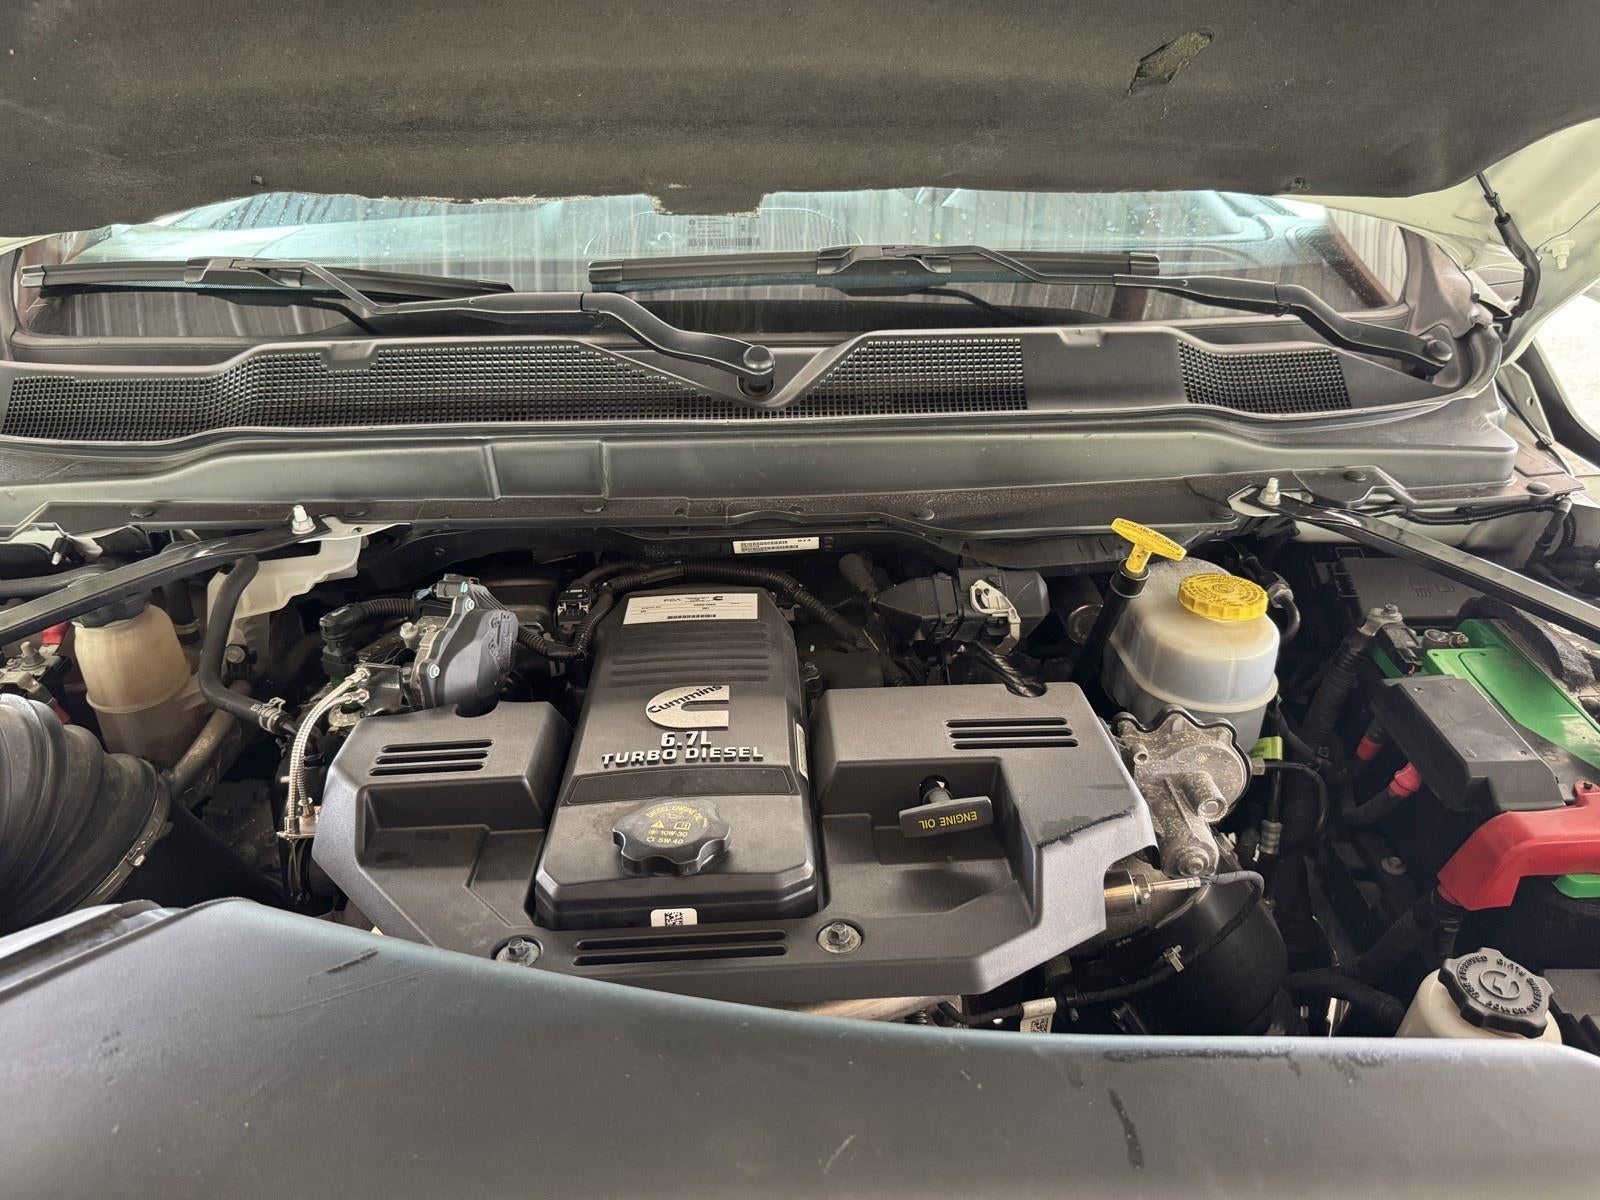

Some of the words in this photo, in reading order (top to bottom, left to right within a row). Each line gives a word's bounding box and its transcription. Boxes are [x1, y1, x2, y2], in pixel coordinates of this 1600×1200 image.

[648, 685, 722, 713] Cummins
[661, 730, 712, 749] 6.7L
[602, 749, 677, 768] TURBO
[685, 746, 764, 762] DIESEL
[918, 819, 935, 829] OIL
[939, 811, 977, 826] ENGINE
